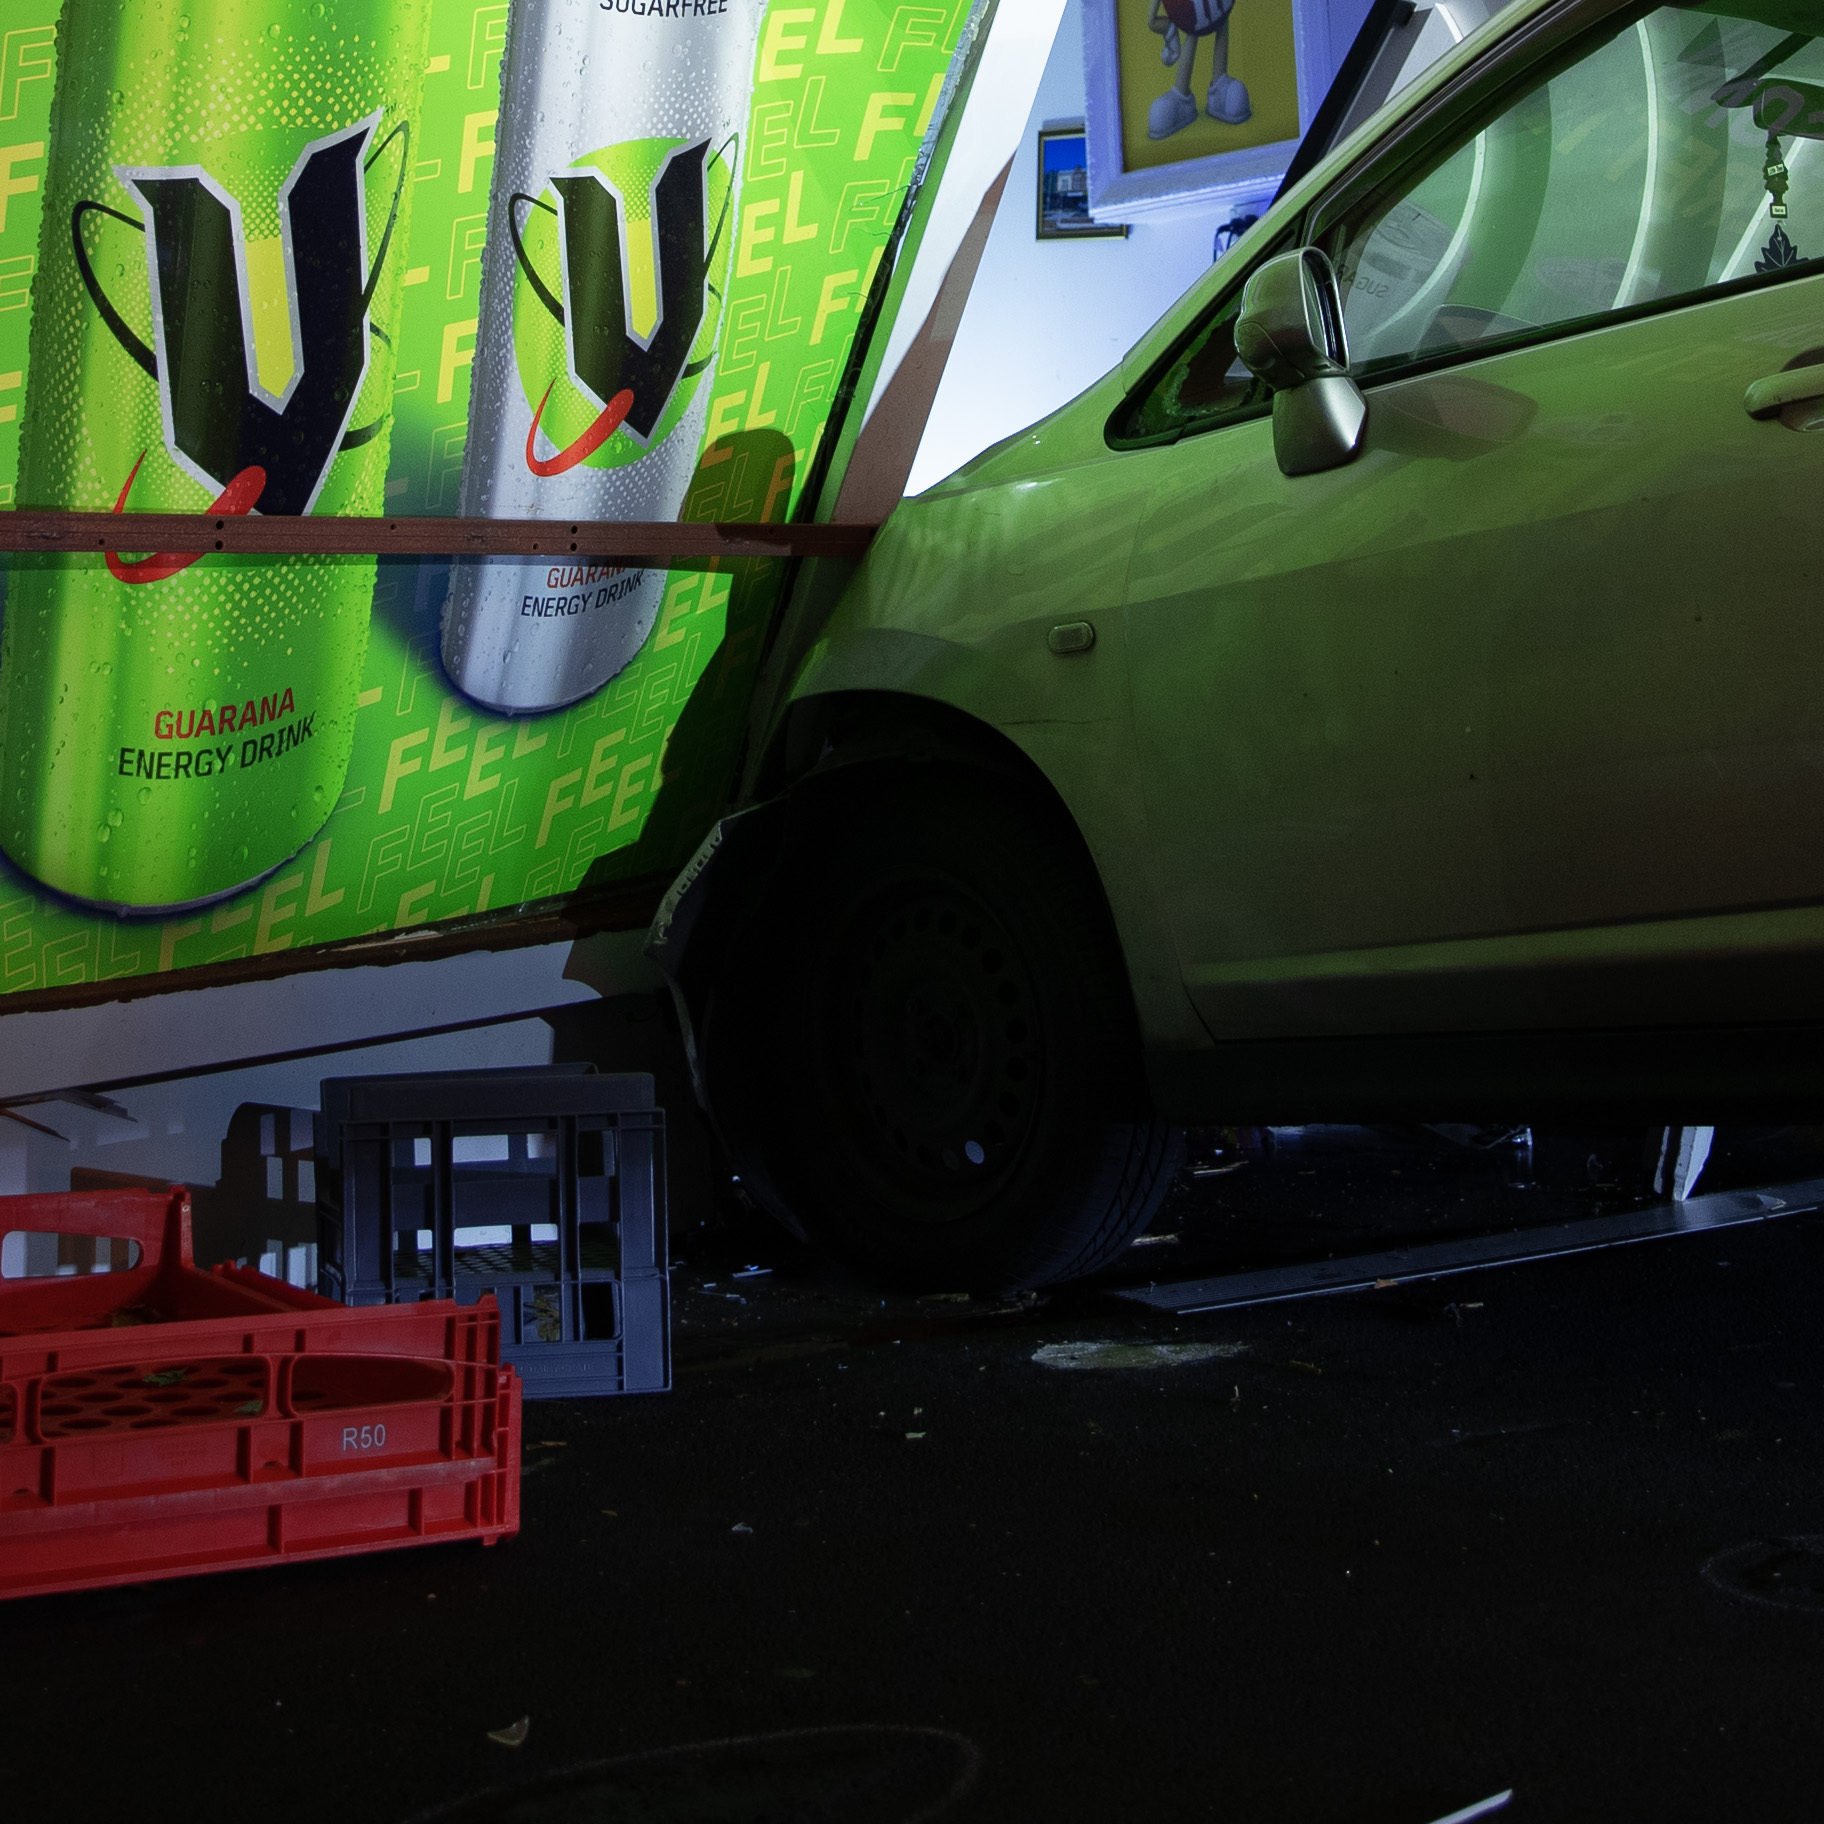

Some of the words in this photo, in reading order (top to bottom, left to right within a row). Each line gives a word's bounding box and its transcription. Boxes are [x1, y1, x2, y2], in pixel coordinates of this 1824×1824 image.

[747, 76, 840, 182] EL
[736, 170, 818, 278] EL
[111, 107, 384, 516] V
[547, 136, 712, 450] V
[719, 265, 801, 376] EL
[700, 362, 777, 469] EL
[521, 592, 593, 617] ENERGY
[595, 568, 644, 609] DRINK
[547, 562, 628, 588] GUARAN
[118, 745, 232, 779] ENERGY
[240, 710, 316, 769] DRINK
[155, 687, 295, 739] GUARANA
[357, 778, 526, 914] FEEL
[341, 1423, 387, 1452] R50
